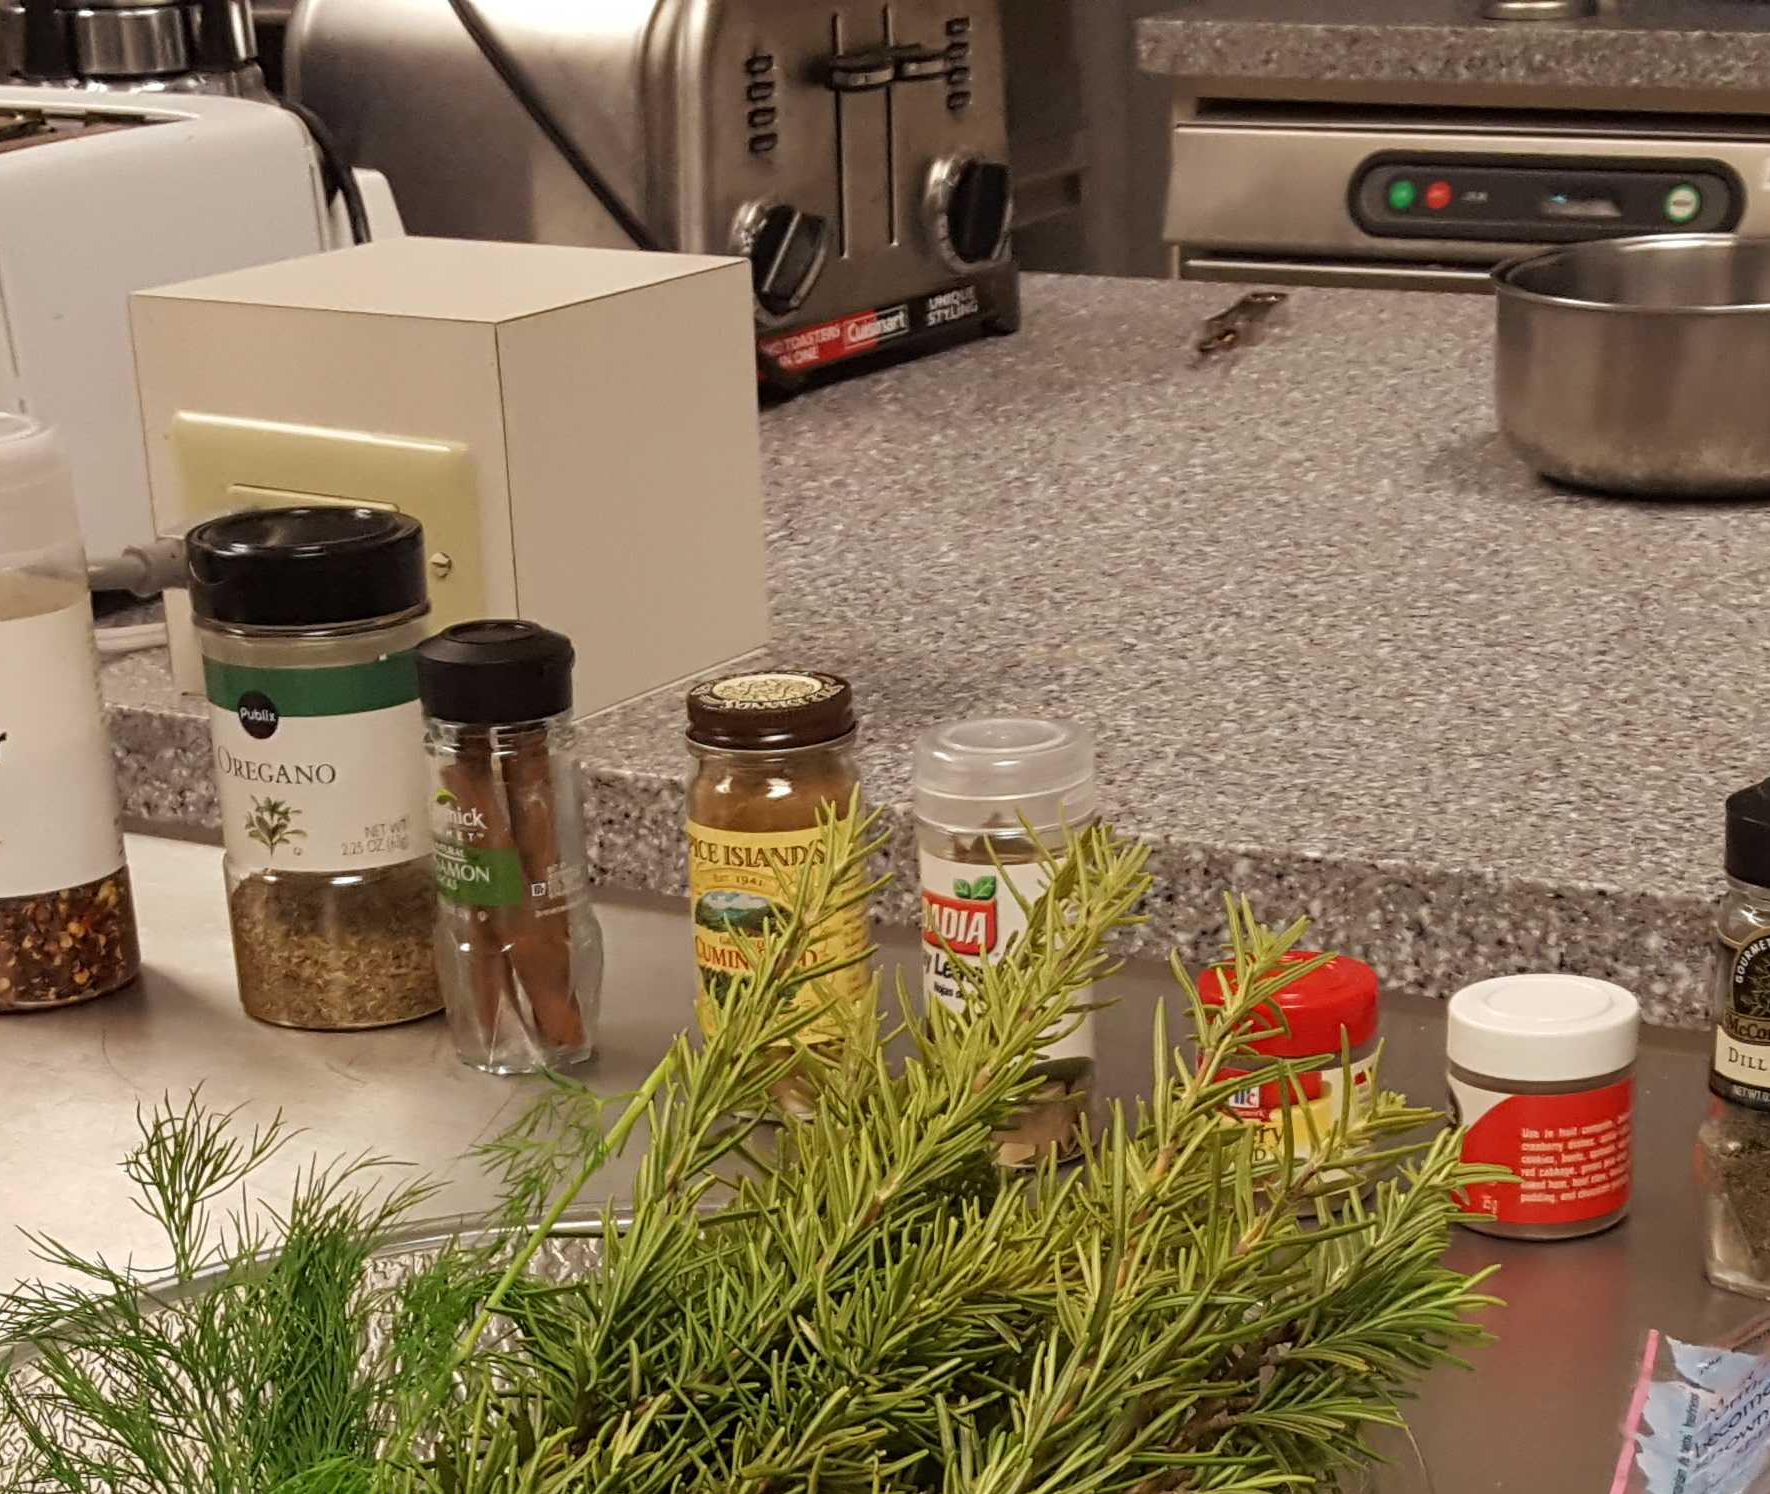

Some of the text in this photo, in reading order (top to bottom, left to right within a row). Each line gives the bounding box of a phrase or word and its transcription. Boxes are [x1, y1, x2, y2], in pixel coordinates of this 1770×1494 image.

[847, 311, 906, 343] Cuisinart
[240, 706, 277, 723] Publix
[695, 935, 750, 970] CUMIN
[1728, 1046, 1768, 1071] DILL
